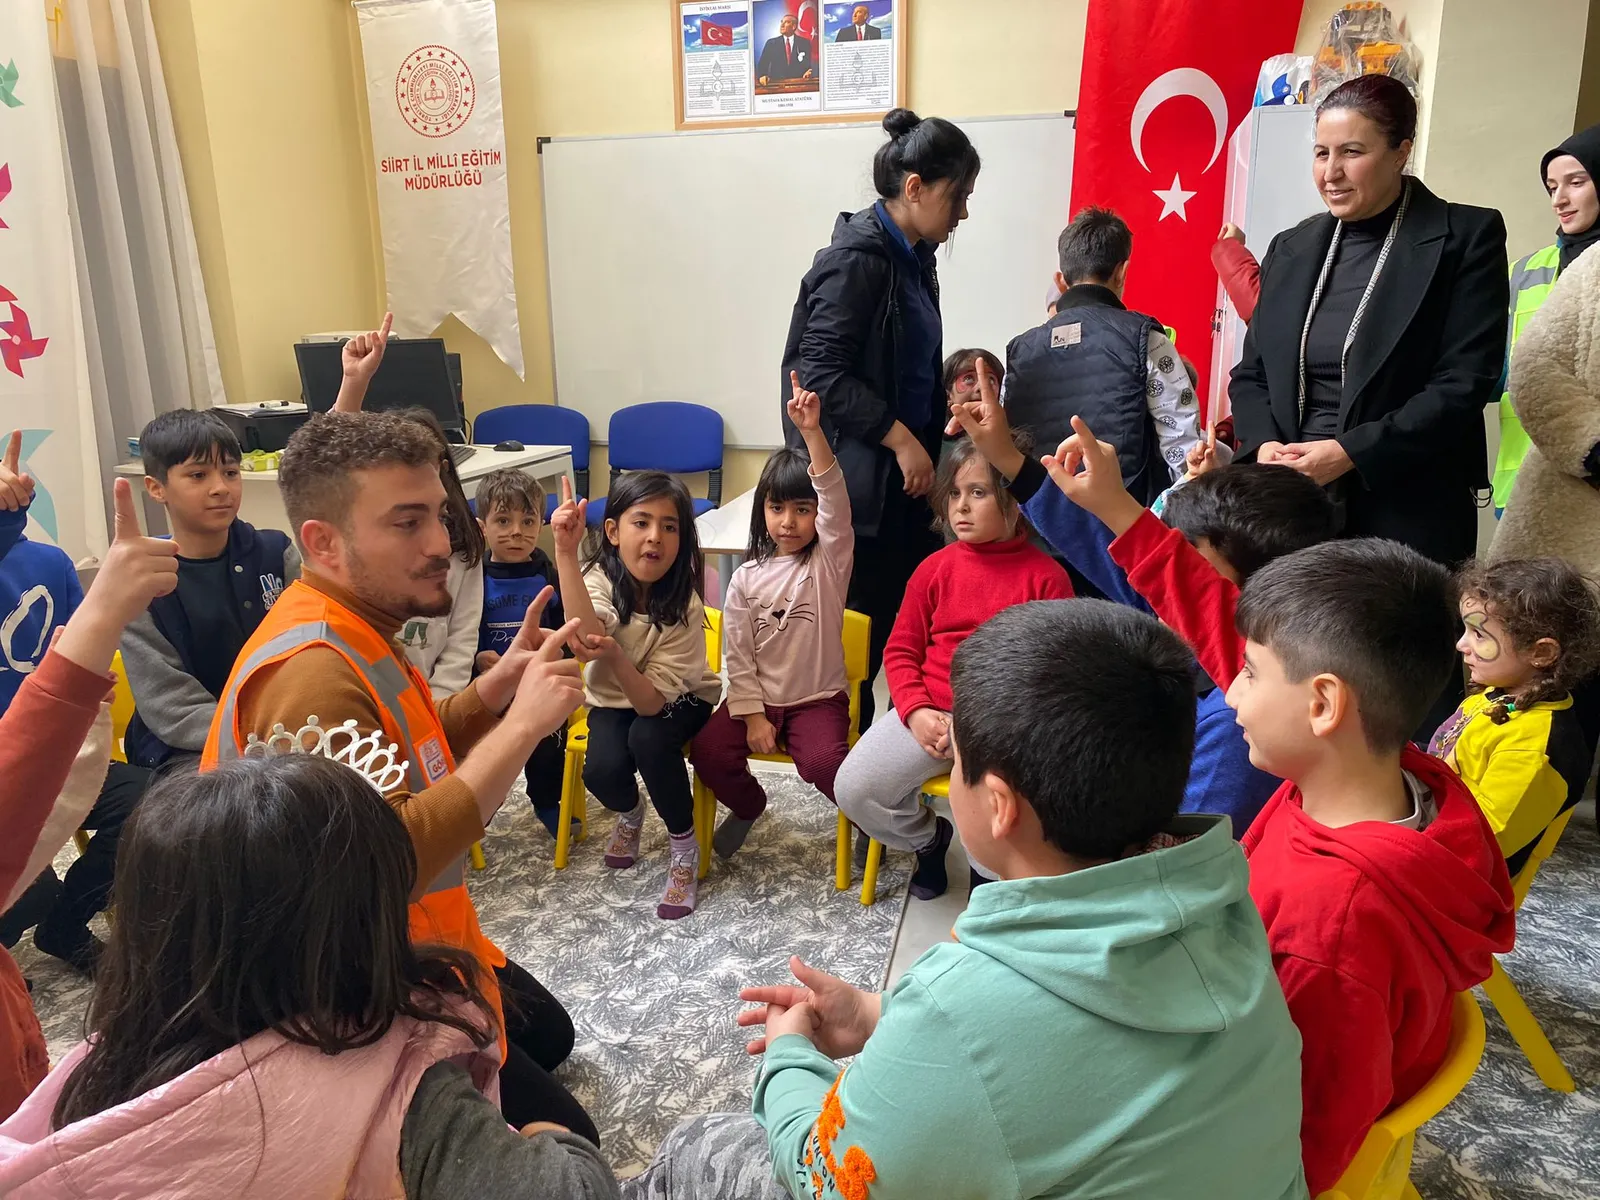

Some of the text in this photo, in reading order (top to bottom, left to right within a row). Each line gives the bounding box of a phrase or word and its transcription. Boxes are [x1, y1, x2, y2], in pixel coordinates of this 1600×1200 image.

[381, 156, 410, 173] SİİRT
[413, 154, 424, 171] İL
[461, 148, 501, 167] EĞİTİM
[404, 169, 482, 191] MÜDÜRLÜĞÜ
